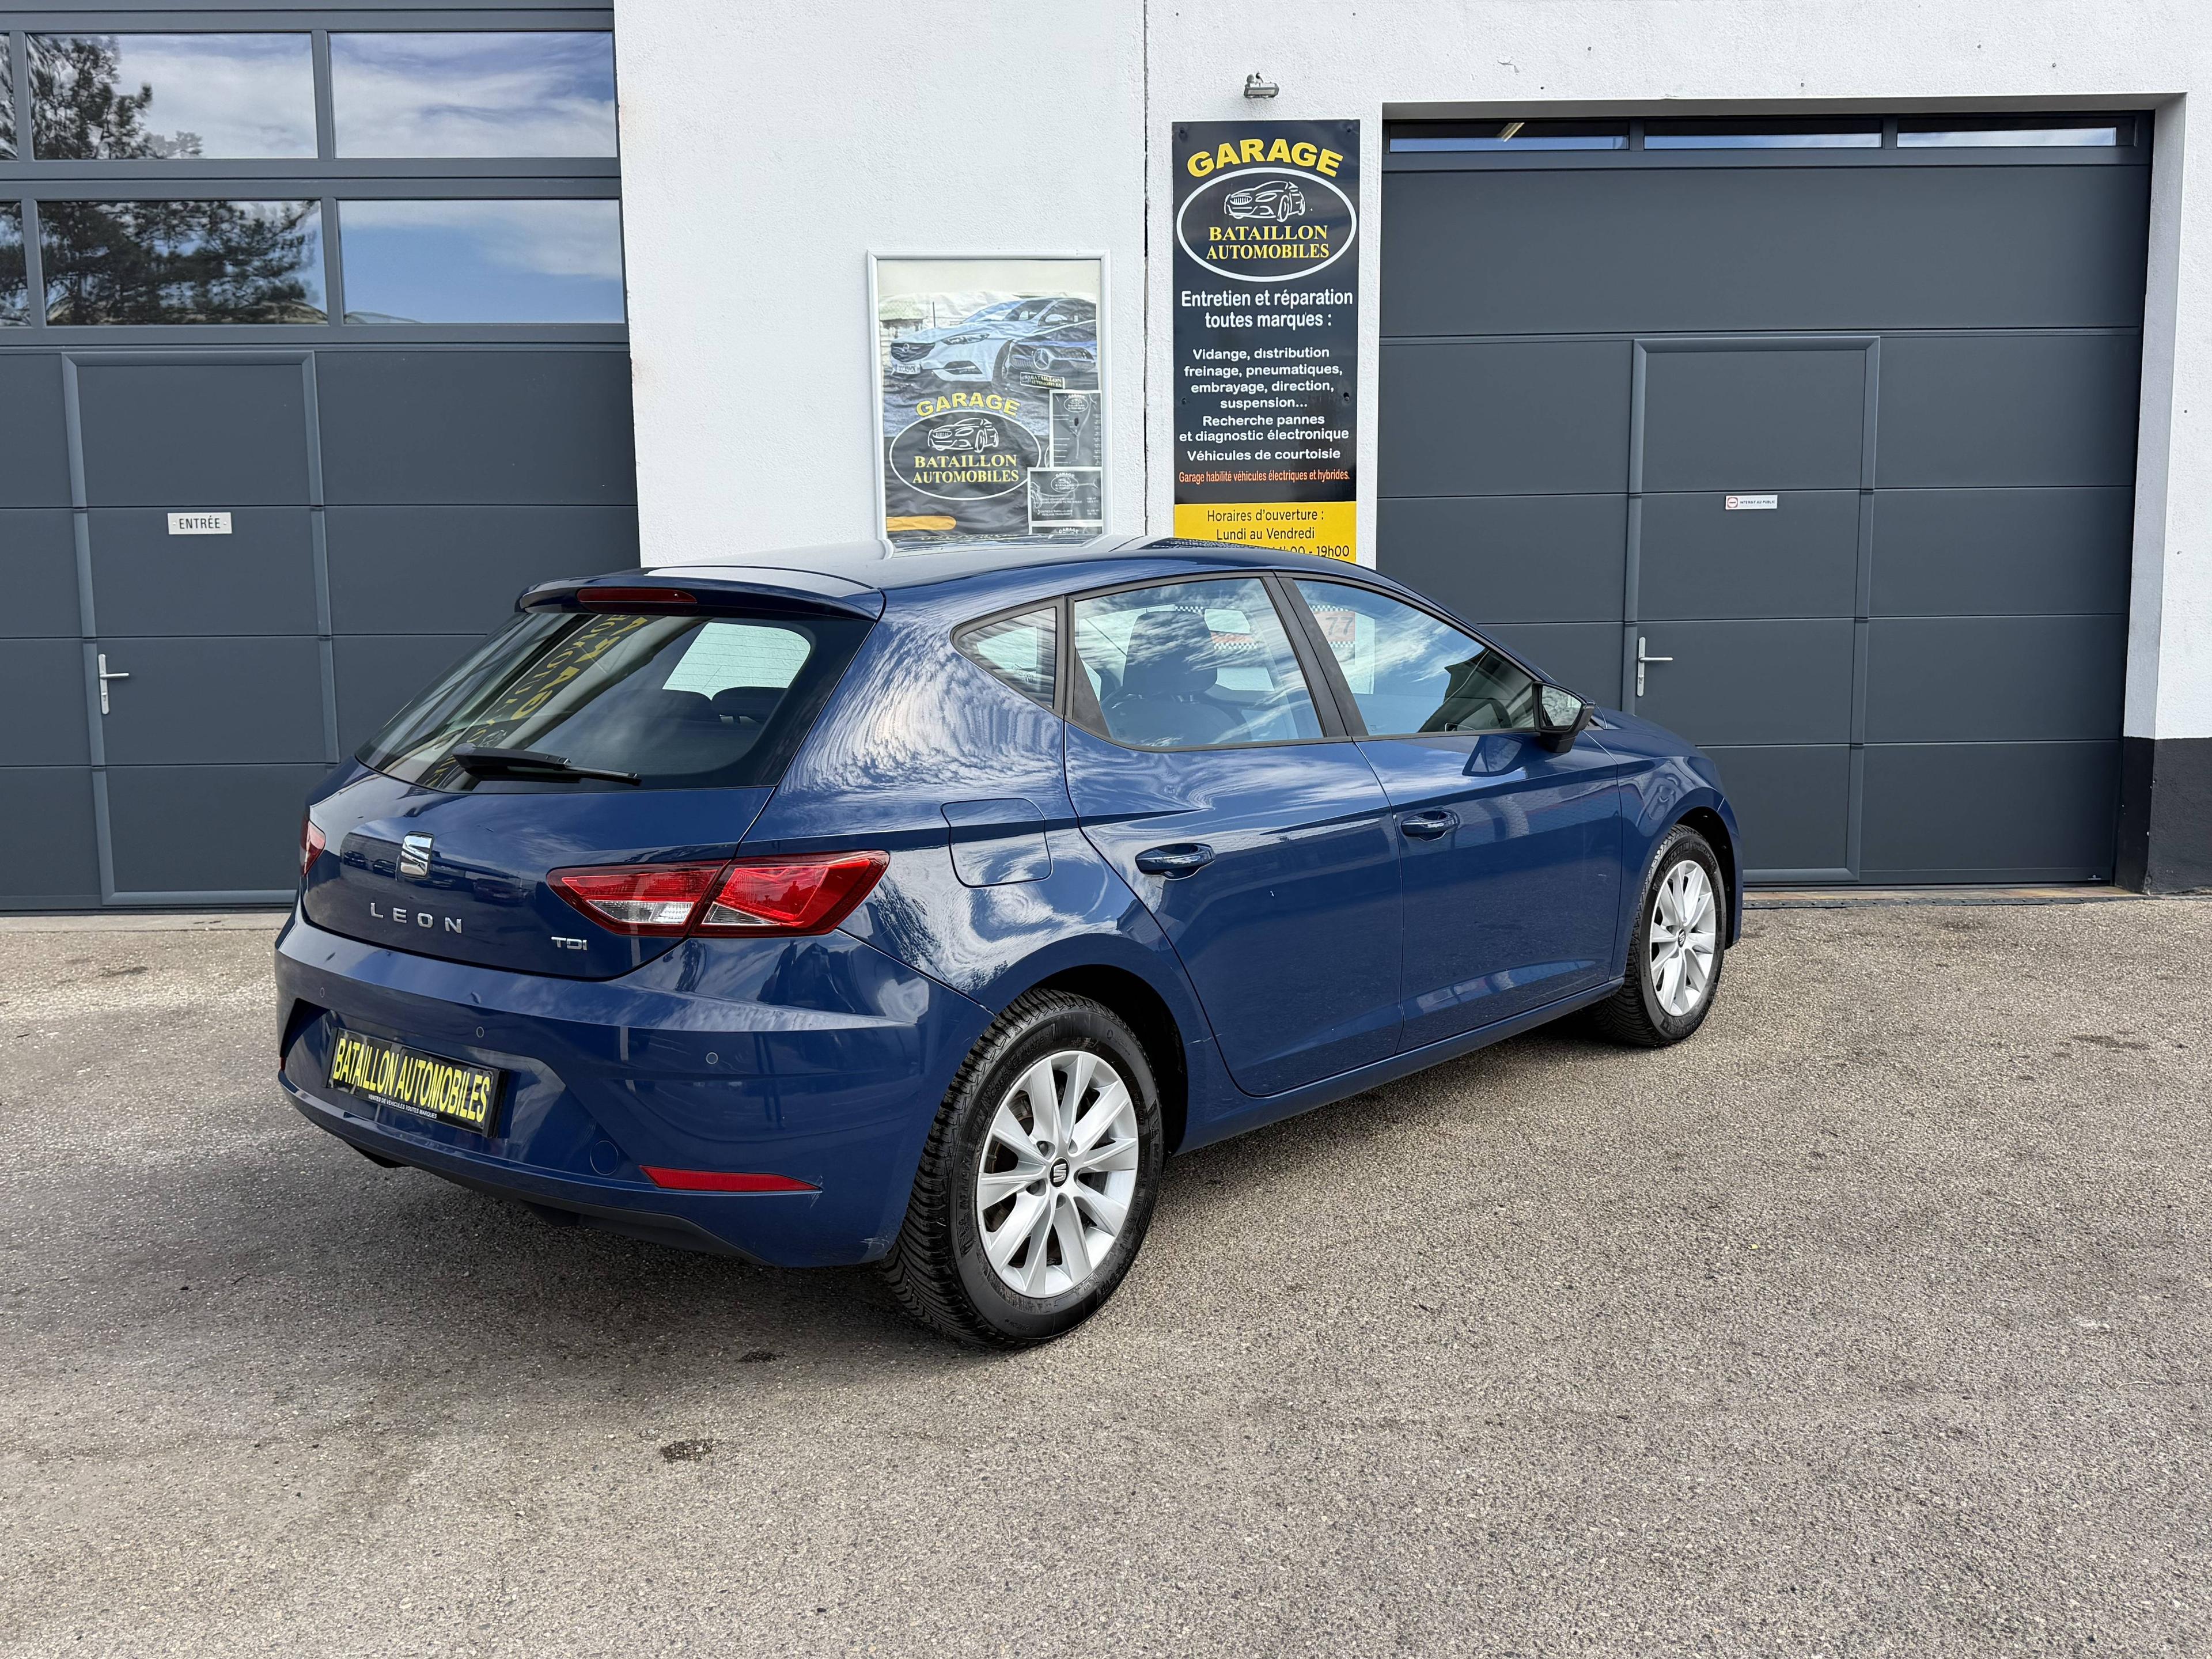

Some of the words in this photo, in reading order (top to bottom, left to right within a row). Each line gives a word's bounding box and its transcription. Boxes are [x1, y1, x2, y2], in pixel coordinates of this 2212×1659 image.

[1187, 138, 1343, 177] GARAGE
[1209, 225, 1328, 241] BATAILLON
[1206, 244, 1329, 259] AUTOMOBILES
[1181, 290, 1251, 306] Entretien
[1255, 290, 1271, 305] et
[1274, 289, 1353, 309] réparation
[1205, 312, 1253, 328] toutes
[1257, 313, 1323, 330] marques
[1192, 349, 1250, 362] Vidange,
[1254, 347, 1329, 358] distribution
[1184, 366, 1243, 378] freinage,
[1246, 364, 1343, 377] pneumatiques,
[1191, 382, 1268, 395] embrayage,
[1272, 381, 1334, 392] direction,
[915, 392, 1021, 417] GARAGE
[1220, 397, 1308, 410] suspension...
[1203, 415, 1273, 426] Recherche
[1277, 415, 1325, 426] pannes
[1179, 432, 1192, 442] et
[1195, 431, 1263, 444] diagnostic
[1267, 427, 1349, 442] électronique
[914, 454, 1017, 468] BATAILLON
[1187, 450, 1251, 461] Véhicules
[1255, 449, 1271, 460] de
[1275, 448, 1340, 459] courtoisie
[912, 469, 1019, 484] AUTOMOBILES
[1179, 472, 1205, 484] Garage
[1206, 471, 1232, 482] habilité
[1234, 471, 1267, 481] véhicules
[1268, 470, 1308, 483] électriques
[1309, 470, 1317, 480] et
[1318, 469, 1350, 483] hybrides.
[179, 515, 220, 529] ENTRÉE
[1207, 510, 1252, 522] Horaires
[1217, 528, 1246, 540] Lundi
[1250, 531, 1262, 539] au
[1266, 527, 1315, 539] Vendredi
[1316, 545, 1350, 557] 19h00
[1325, 616, 1354, 635] 77
[370, 902, 462, 934] LEON
[551, 936, 588, 950] TDI
[333, 1038, 399, 1096] BATAILLON
[395, 1055, 490, 1122] AUTOMOBILES
[406, 1105, 419, 1113] TOUTES
[419, 1109, 437, 1119] MARQUES
